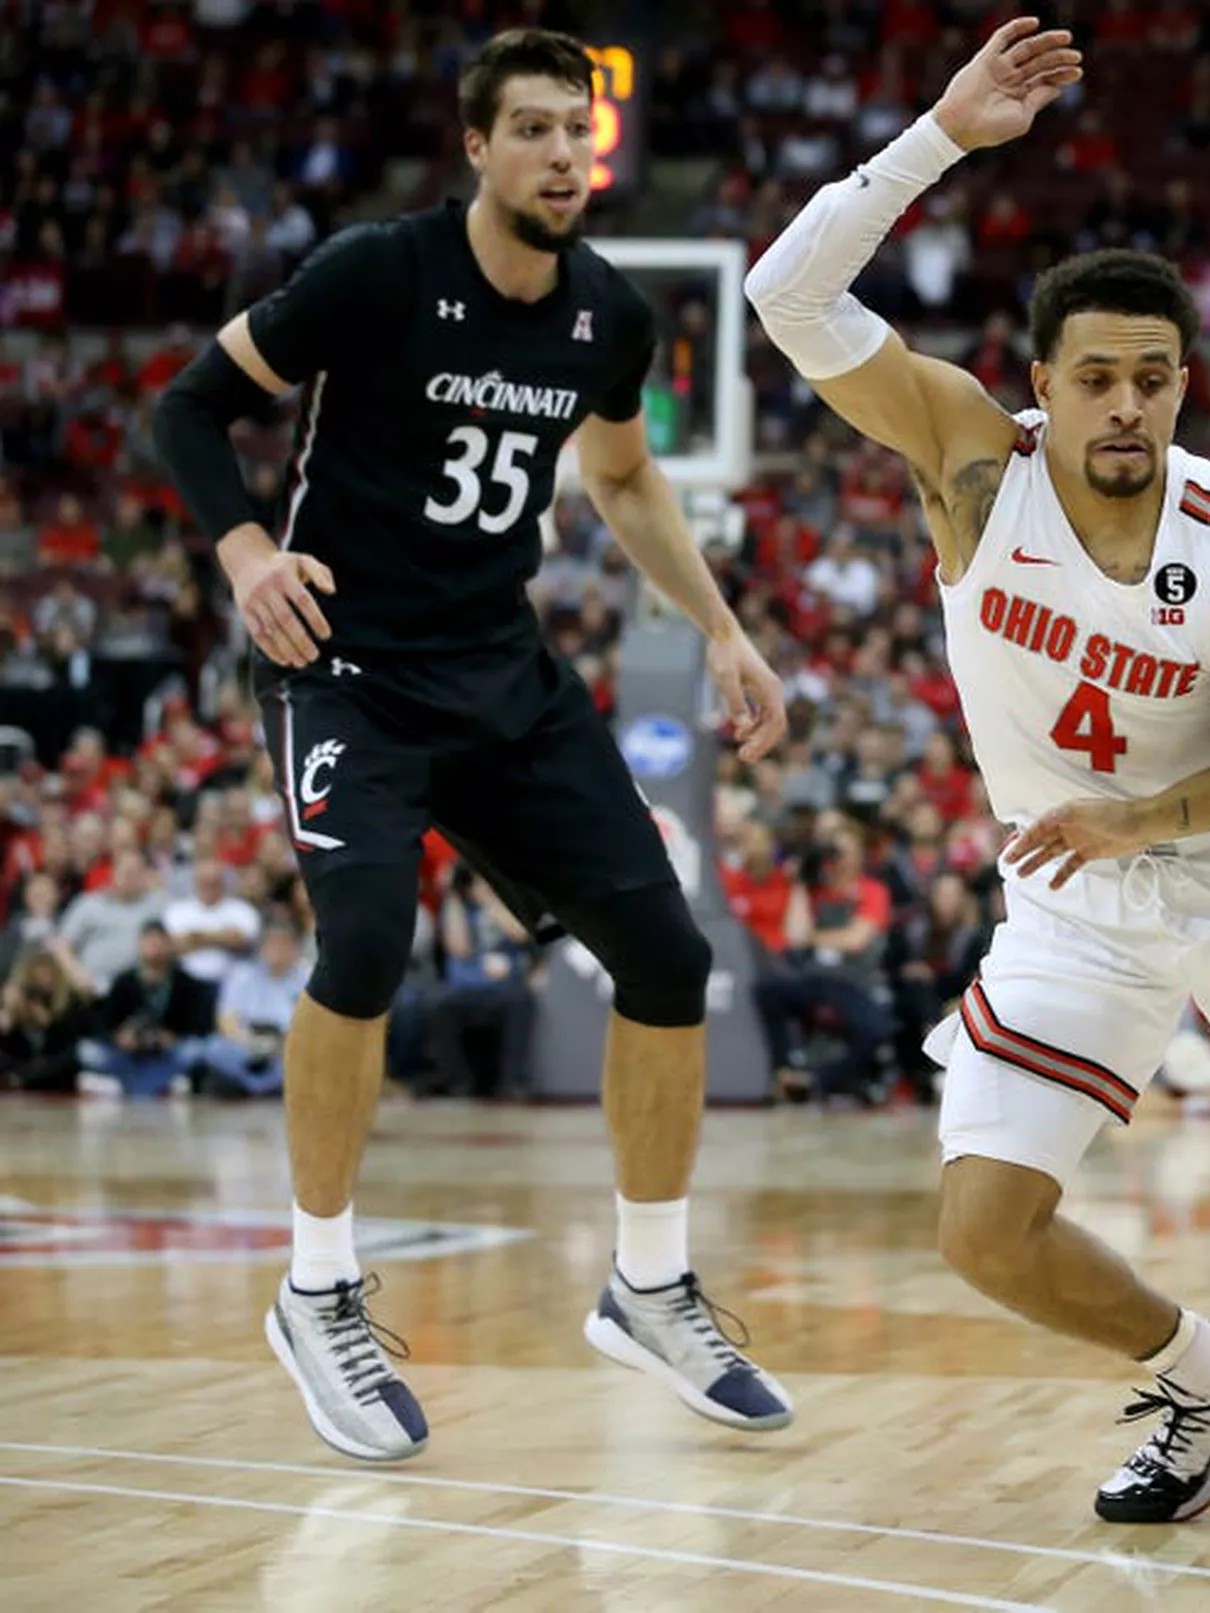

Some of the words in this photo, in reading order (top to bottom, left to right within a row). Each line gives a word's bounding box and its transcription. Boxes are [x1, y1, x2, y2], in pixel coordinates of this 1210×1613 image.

[425, 371, 579, 419] CINCINNATI
[424, 425, 539, 534] 35
[1166, 575, 1185, 602] 5
[979, 587, 1078, 663] OHIO
[1079, 633, 1201, 698] STATE
[1049, 679, 1127, 774] 4
